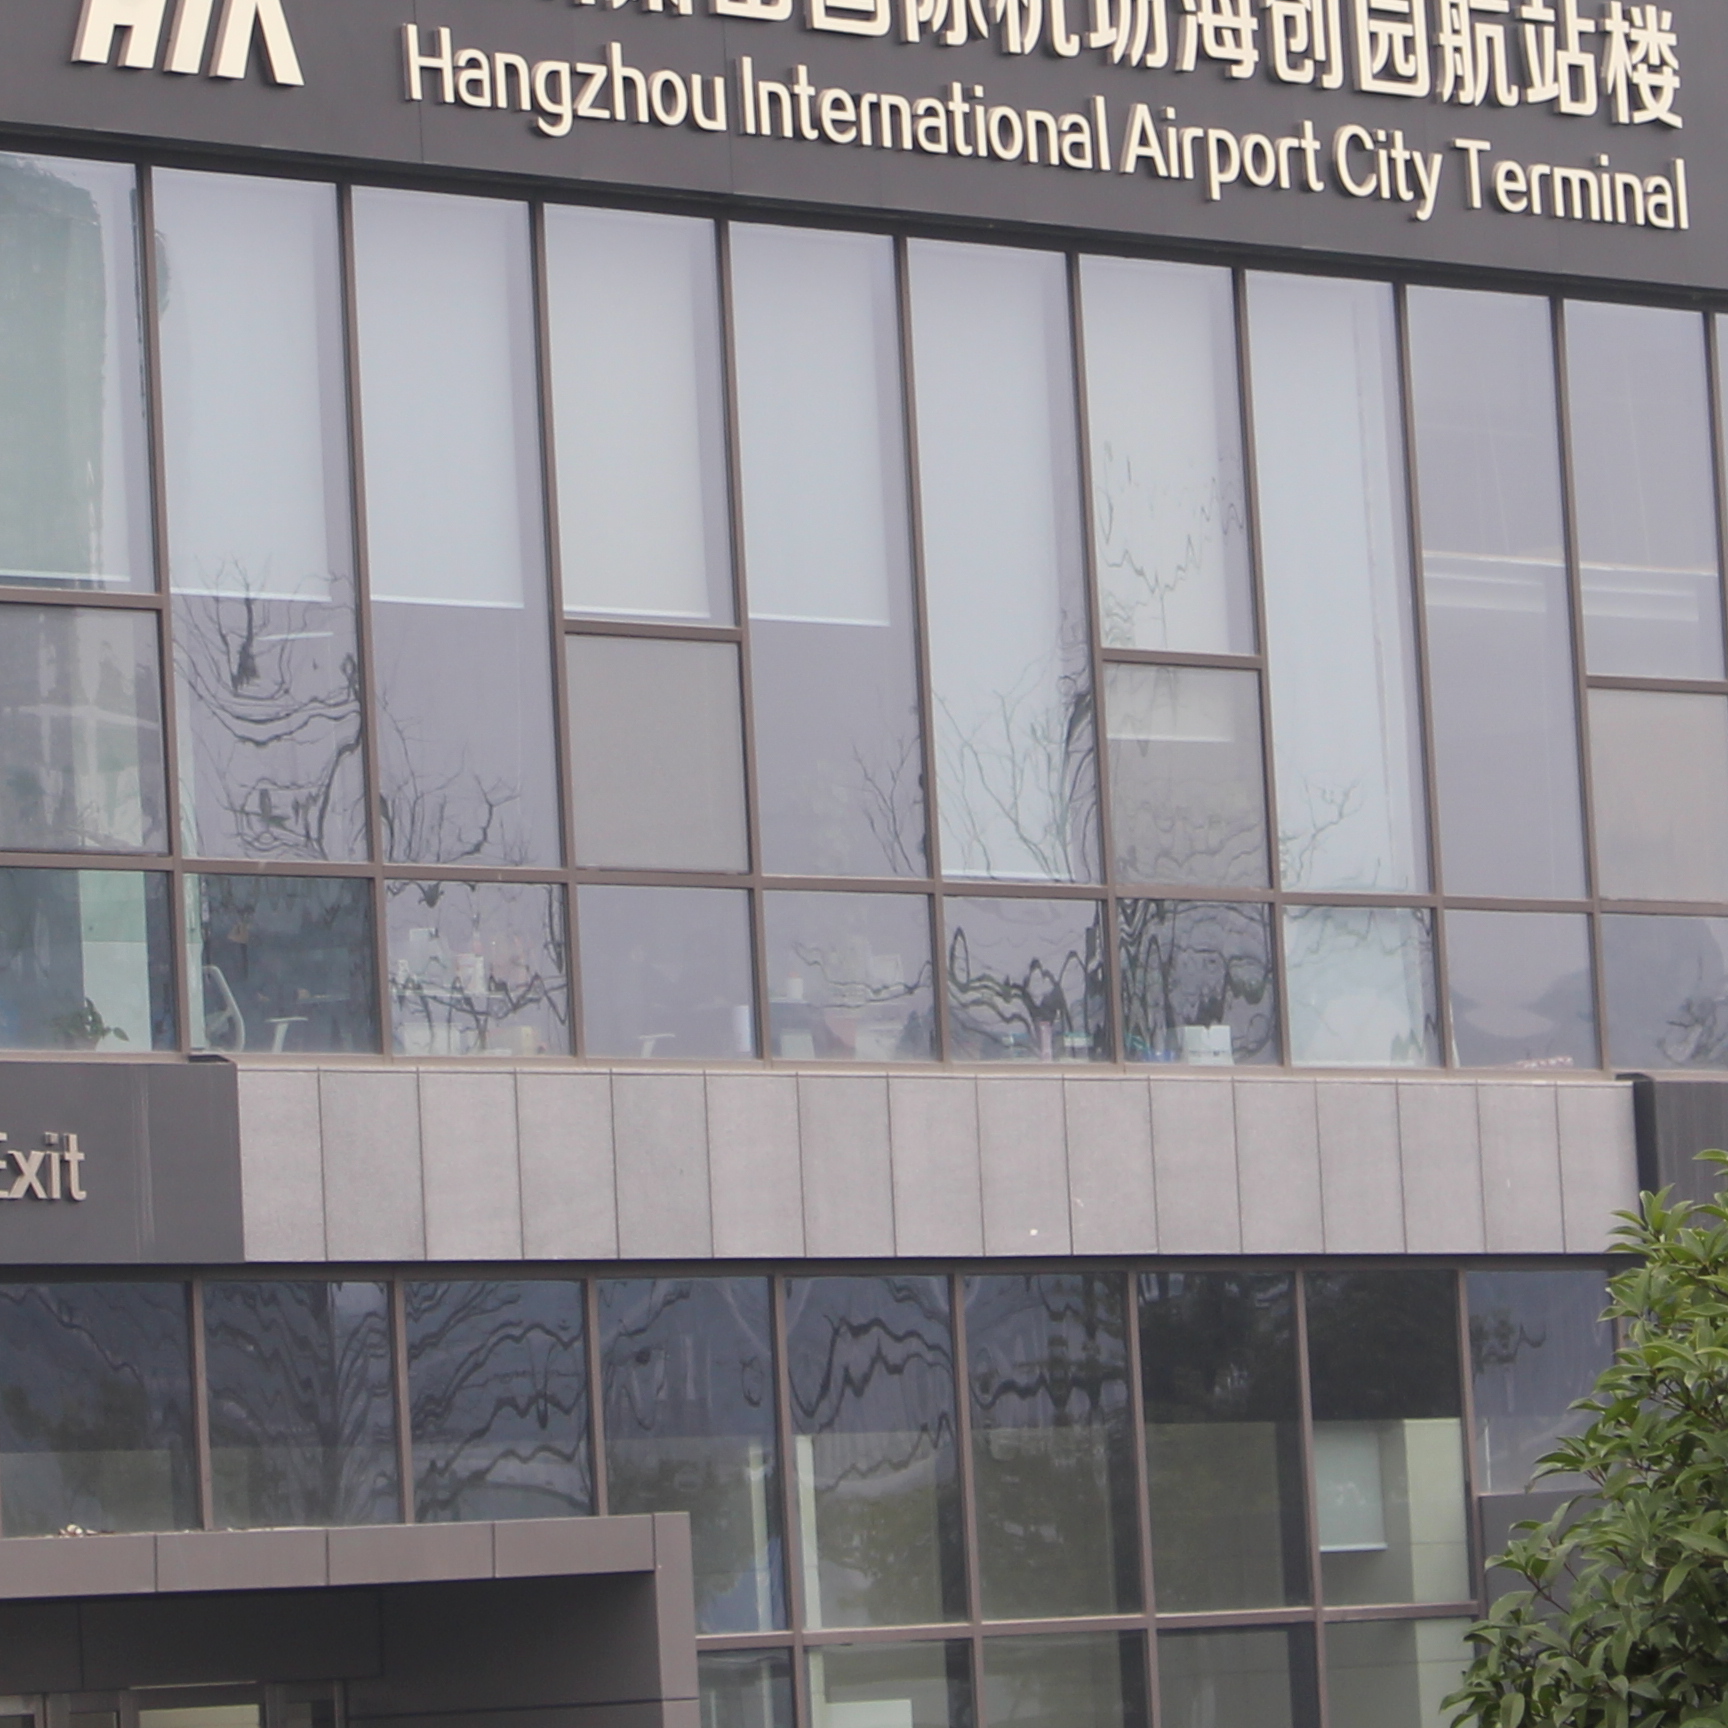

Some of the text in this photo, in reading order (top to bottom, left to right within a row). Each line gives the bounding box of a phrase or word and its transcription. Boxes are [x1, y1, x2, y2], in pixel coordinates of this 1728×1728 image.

[405, 22, 1691, 231] Hangzhou International Airport City Terminal
